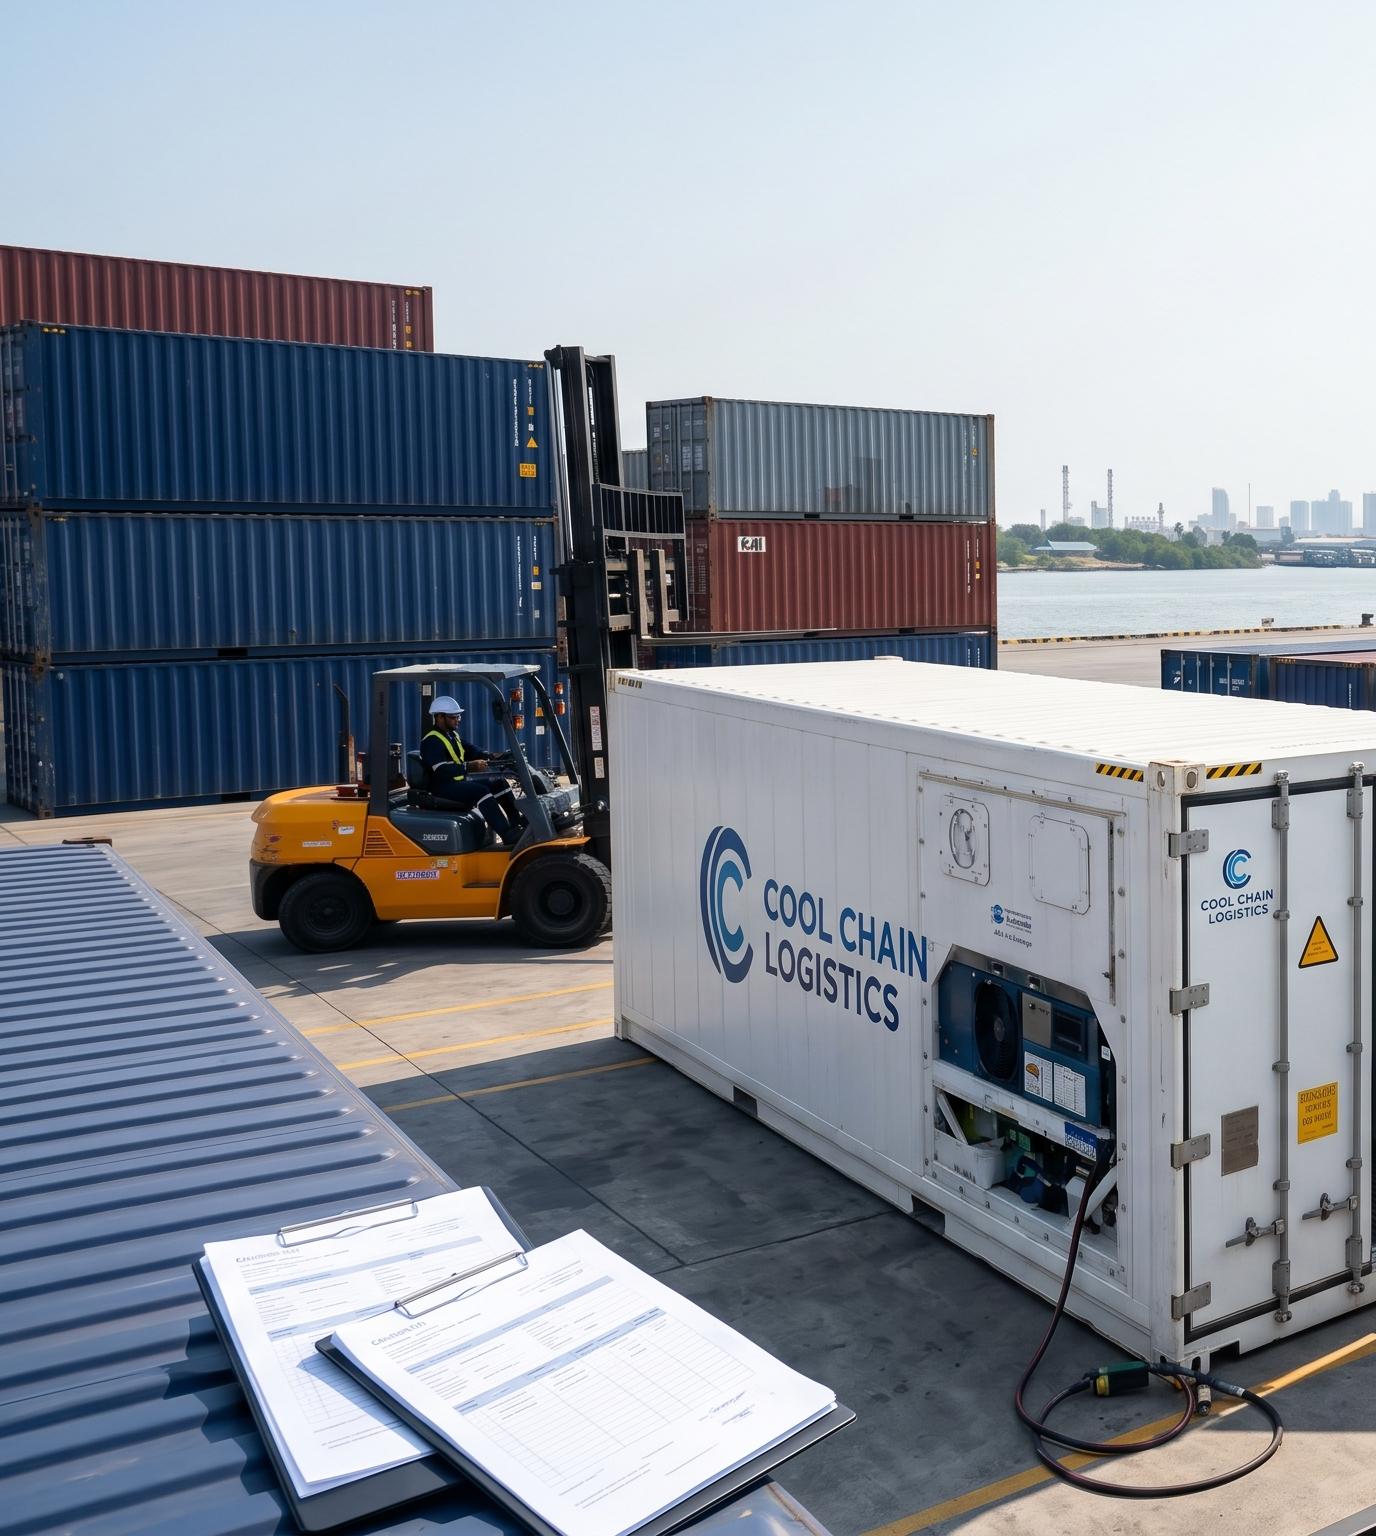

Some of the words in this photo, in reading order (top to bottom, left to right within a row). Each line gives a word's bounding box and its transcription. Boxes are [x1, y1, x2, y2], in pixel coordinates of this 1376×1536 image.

[764, 878, 832, 944] COOL
[839, 906, 928, 983] CHAIN
[1201, 896, 1234, 911] COOL
[1237, 889, 1273, 905] CHAIN
[1208, 903, 1269, 924] LOGISTICS
[765, 931, 899, 1032] LOGISTICS
